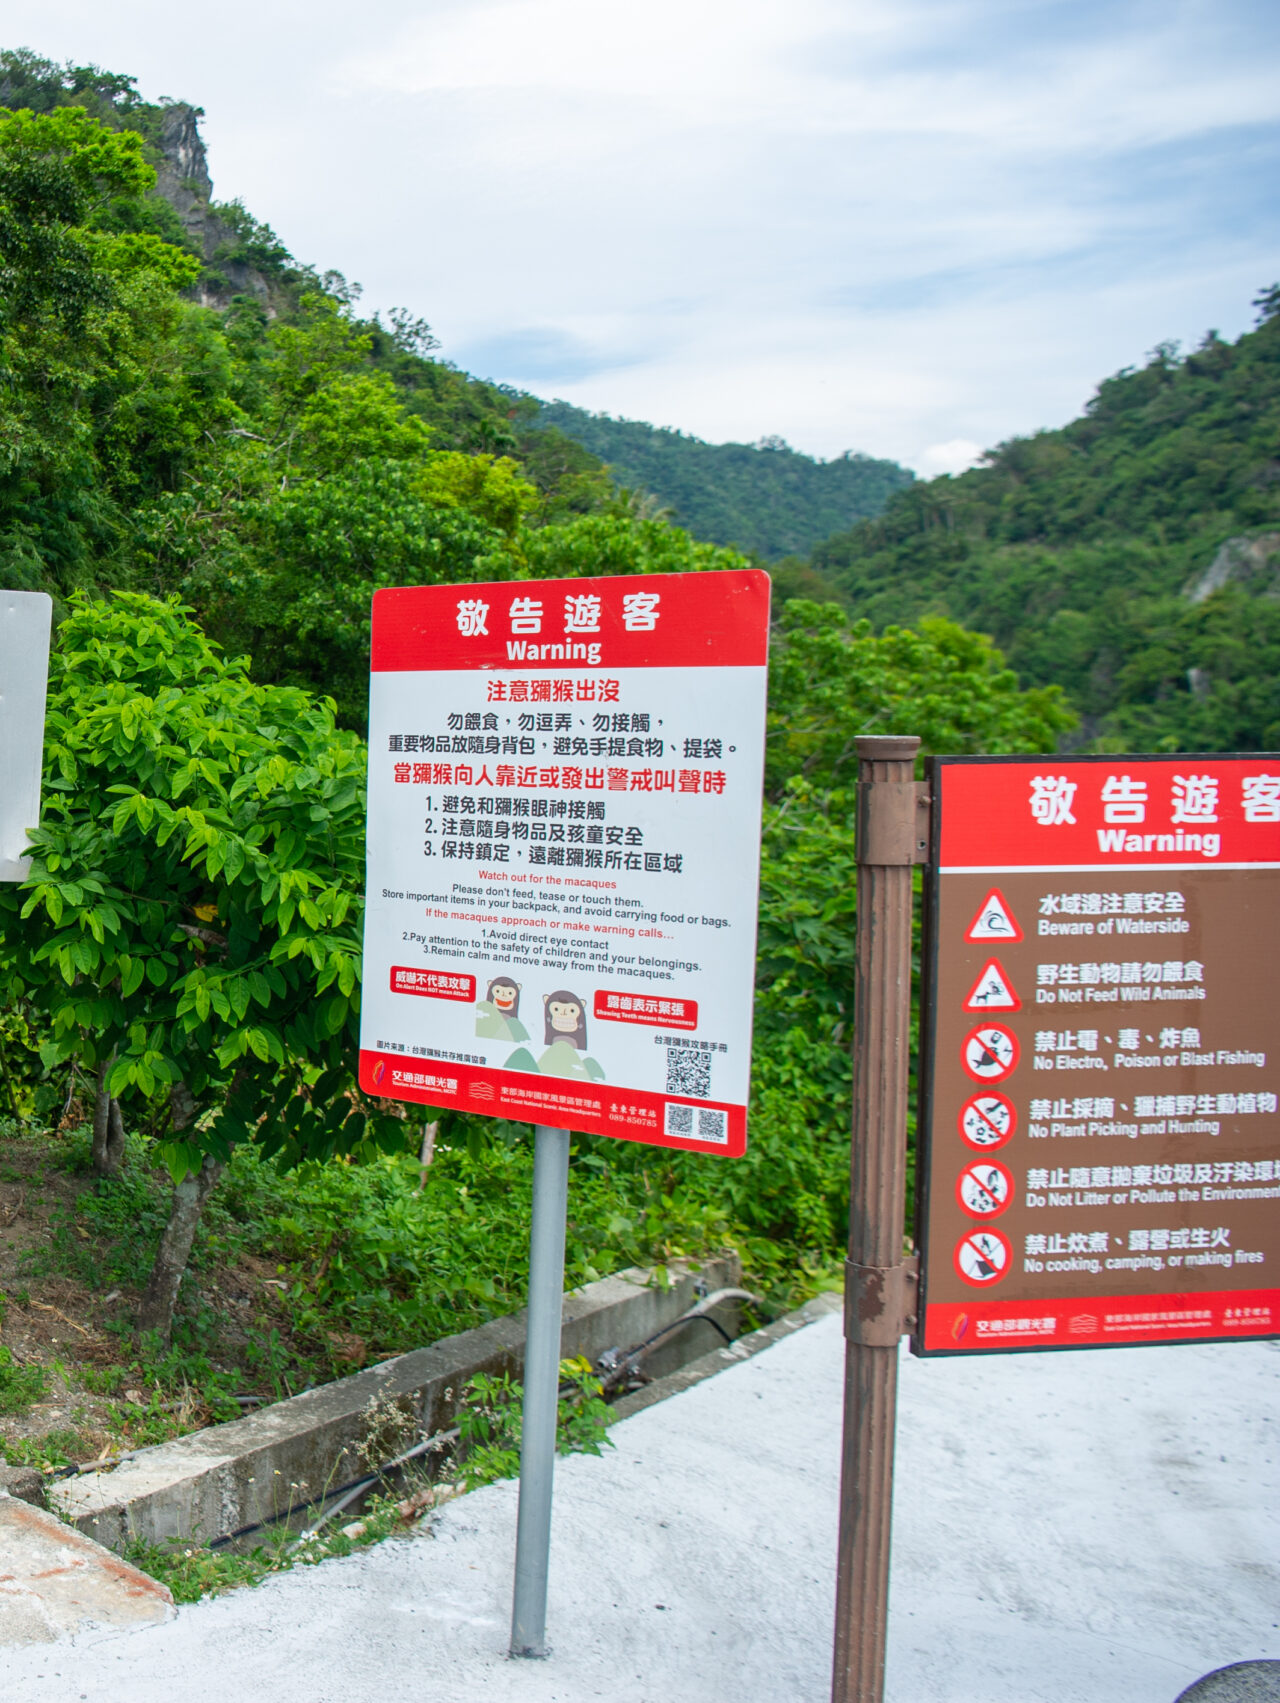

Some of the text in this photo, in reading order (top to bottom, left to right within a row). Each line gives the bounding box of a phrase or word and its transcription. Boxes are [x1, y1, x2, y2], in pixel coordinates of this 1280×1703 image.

[456, 592, 660, 636] 敬告遊客
[506, 638, 601, 664] Warning
[487, 678, 620, 703] 注意獼猴出沒
[393, 762, 726, 795] 當獼猴向人靠近或發出警戒叫聲時
[1028, 774, 1280, 825] 敬告遊客
[1096, 828, 1221, 857] Warning
[479, 870, 617, 890] Watch out for the macaques
[452, 884, 483, 895] Please
[486, 886, 510, 897] don't
[512, 888, 536, 900] feed,
[539, 891, 566, 902] tease
[582, 894, 611, 905] touch
[614, 897, 644, 908] them.
[1038, 891, 1186, 915] 水域邊注意安全
[382, 889, 732, 928] Store important items in your backpack, and avoid carrying food or bags.
[425, 908, 432, 917] If
[434, 908, 449, 919] the
[450, 912, 499, 924] macaques
[501, 915, 547, 928] approach
[549, 920, 560, 929] or
[563, 921, 590, 932] make
[593, 924, 635, 938] warning
[1038, 917, 1190, 936] Beware of Waterside
[402, 931, 702, 972] 2.Pay attention to the safety of children and your belongings.
[481, 929, 609, 950] 1.Avoid direct eye contact
[423, 944, 675, 980] 3.Remain calm and move away from the macaques.
[1036, 960, 1204, 985] 野生動物請勿餵食
[606, 995, 684, 1017] 露齒表示緊張
[1036, 985, 1207, 1003] Do Not Feed Wild Animals
[1033, 1050, 1266, 1071] No Electro, Poison or Blast Fishing
[392, 1070, 458, 1089] 交通部觀光署
[608, 1113, 657, 1128] 089-850785
[1028, 1118, 1221, 1139] No Plant Picking and Hunting
[1025, 1185, 1280, 1207] Do Not Litter or Pollute the Environmen
[1024, 1249, 1265, 1273] No cooking, camping, or making fires
